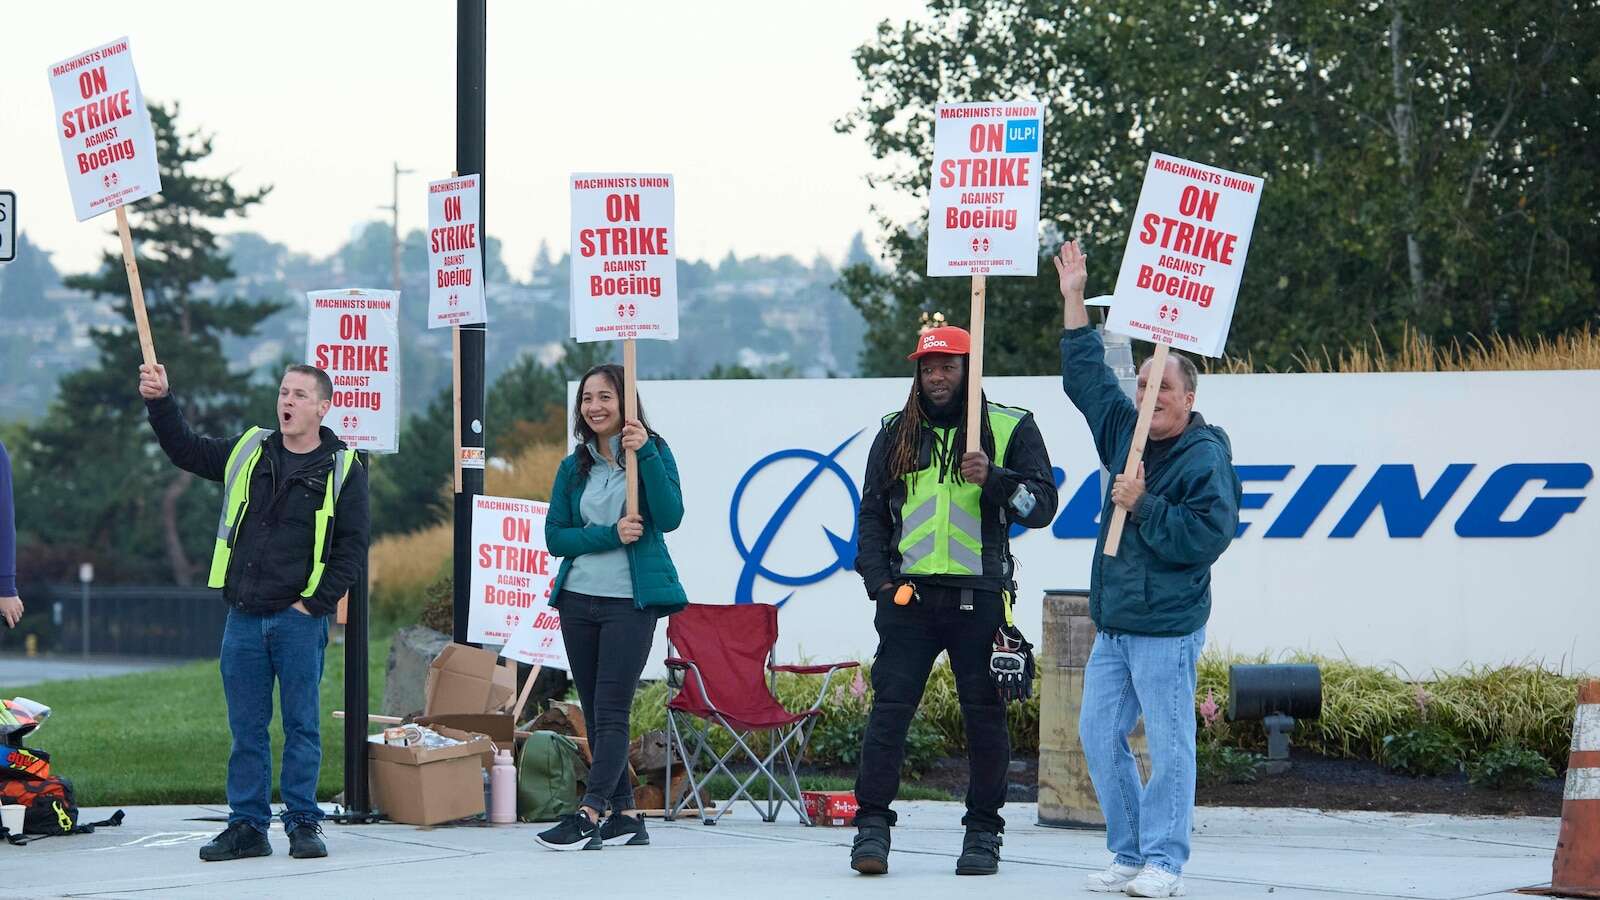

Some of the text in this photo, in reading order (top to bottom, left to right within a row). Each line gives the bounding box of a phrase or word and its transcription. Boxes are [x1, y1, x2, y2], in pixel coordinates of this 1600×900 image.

[53, 42, 128, 78] MACHINISTS UNION
[78, 65, 107, 99] ON
[63, 89, 133, 140] STRIKE
[940, 107, 1036, 118] MACHINISTS UNION
[83, 126, 119, 149] AGAINST
[969, 123, 1004, 154] ON
[1010, 128, 1035, 140] ULP!
[76, 140, 135, 176] Boeing
[575, 178, 669, 188] MACHINISTS UNION
[940, 157, 1030, 189] STRIKE
[1155, 160, 1254, 192] MACHINISTS UNION
[431, 180, 474, 192] MACHINISTS UNION
[444, 197, 461, 222] ON
[605, 193, 640, 223] ON
[960, 193, 1003, 204] AGAINST
[1178, 185, 1220, 223] ON
[945, 207, 1017, 231] Boeing
[431, 224, 475, 254] STRIKE
[579, 227, 669, 257] STRIKE
[1139, 212, 1237, 266] STRIKE
[445, 256, 463, 265] AGAINST
[604, 261, 645, 273] AGAINST
[1157, 254, 1206, 278] AGAINST
[437, 267, 471, 288] Boeing
[590, 273, 661, 298] Boeing
[1136, 263, 1215, 309] Boeing
[316, 300, 390, 309] MACHINISTS UNION
[340, 314, 367, 340] ON
[1151, 326, 1174, 336] DISTRICT
[1174, 330, 1189, 340] LODGE
[923, 341, 948, 350] GOOD.
[315, 344, 388, 372] STRIKE
[334, 376, 368, 387] AGAINST
[333, 388, 381, 411] oeing
[477, 500, 529, 512] MACHINISTS
[502, 516, 531, 544] ON
[480, 543, 549, 576] STRIKE
[498, 576, 528, 587] AGAINST
[485, 587, 535, 608] Boein
